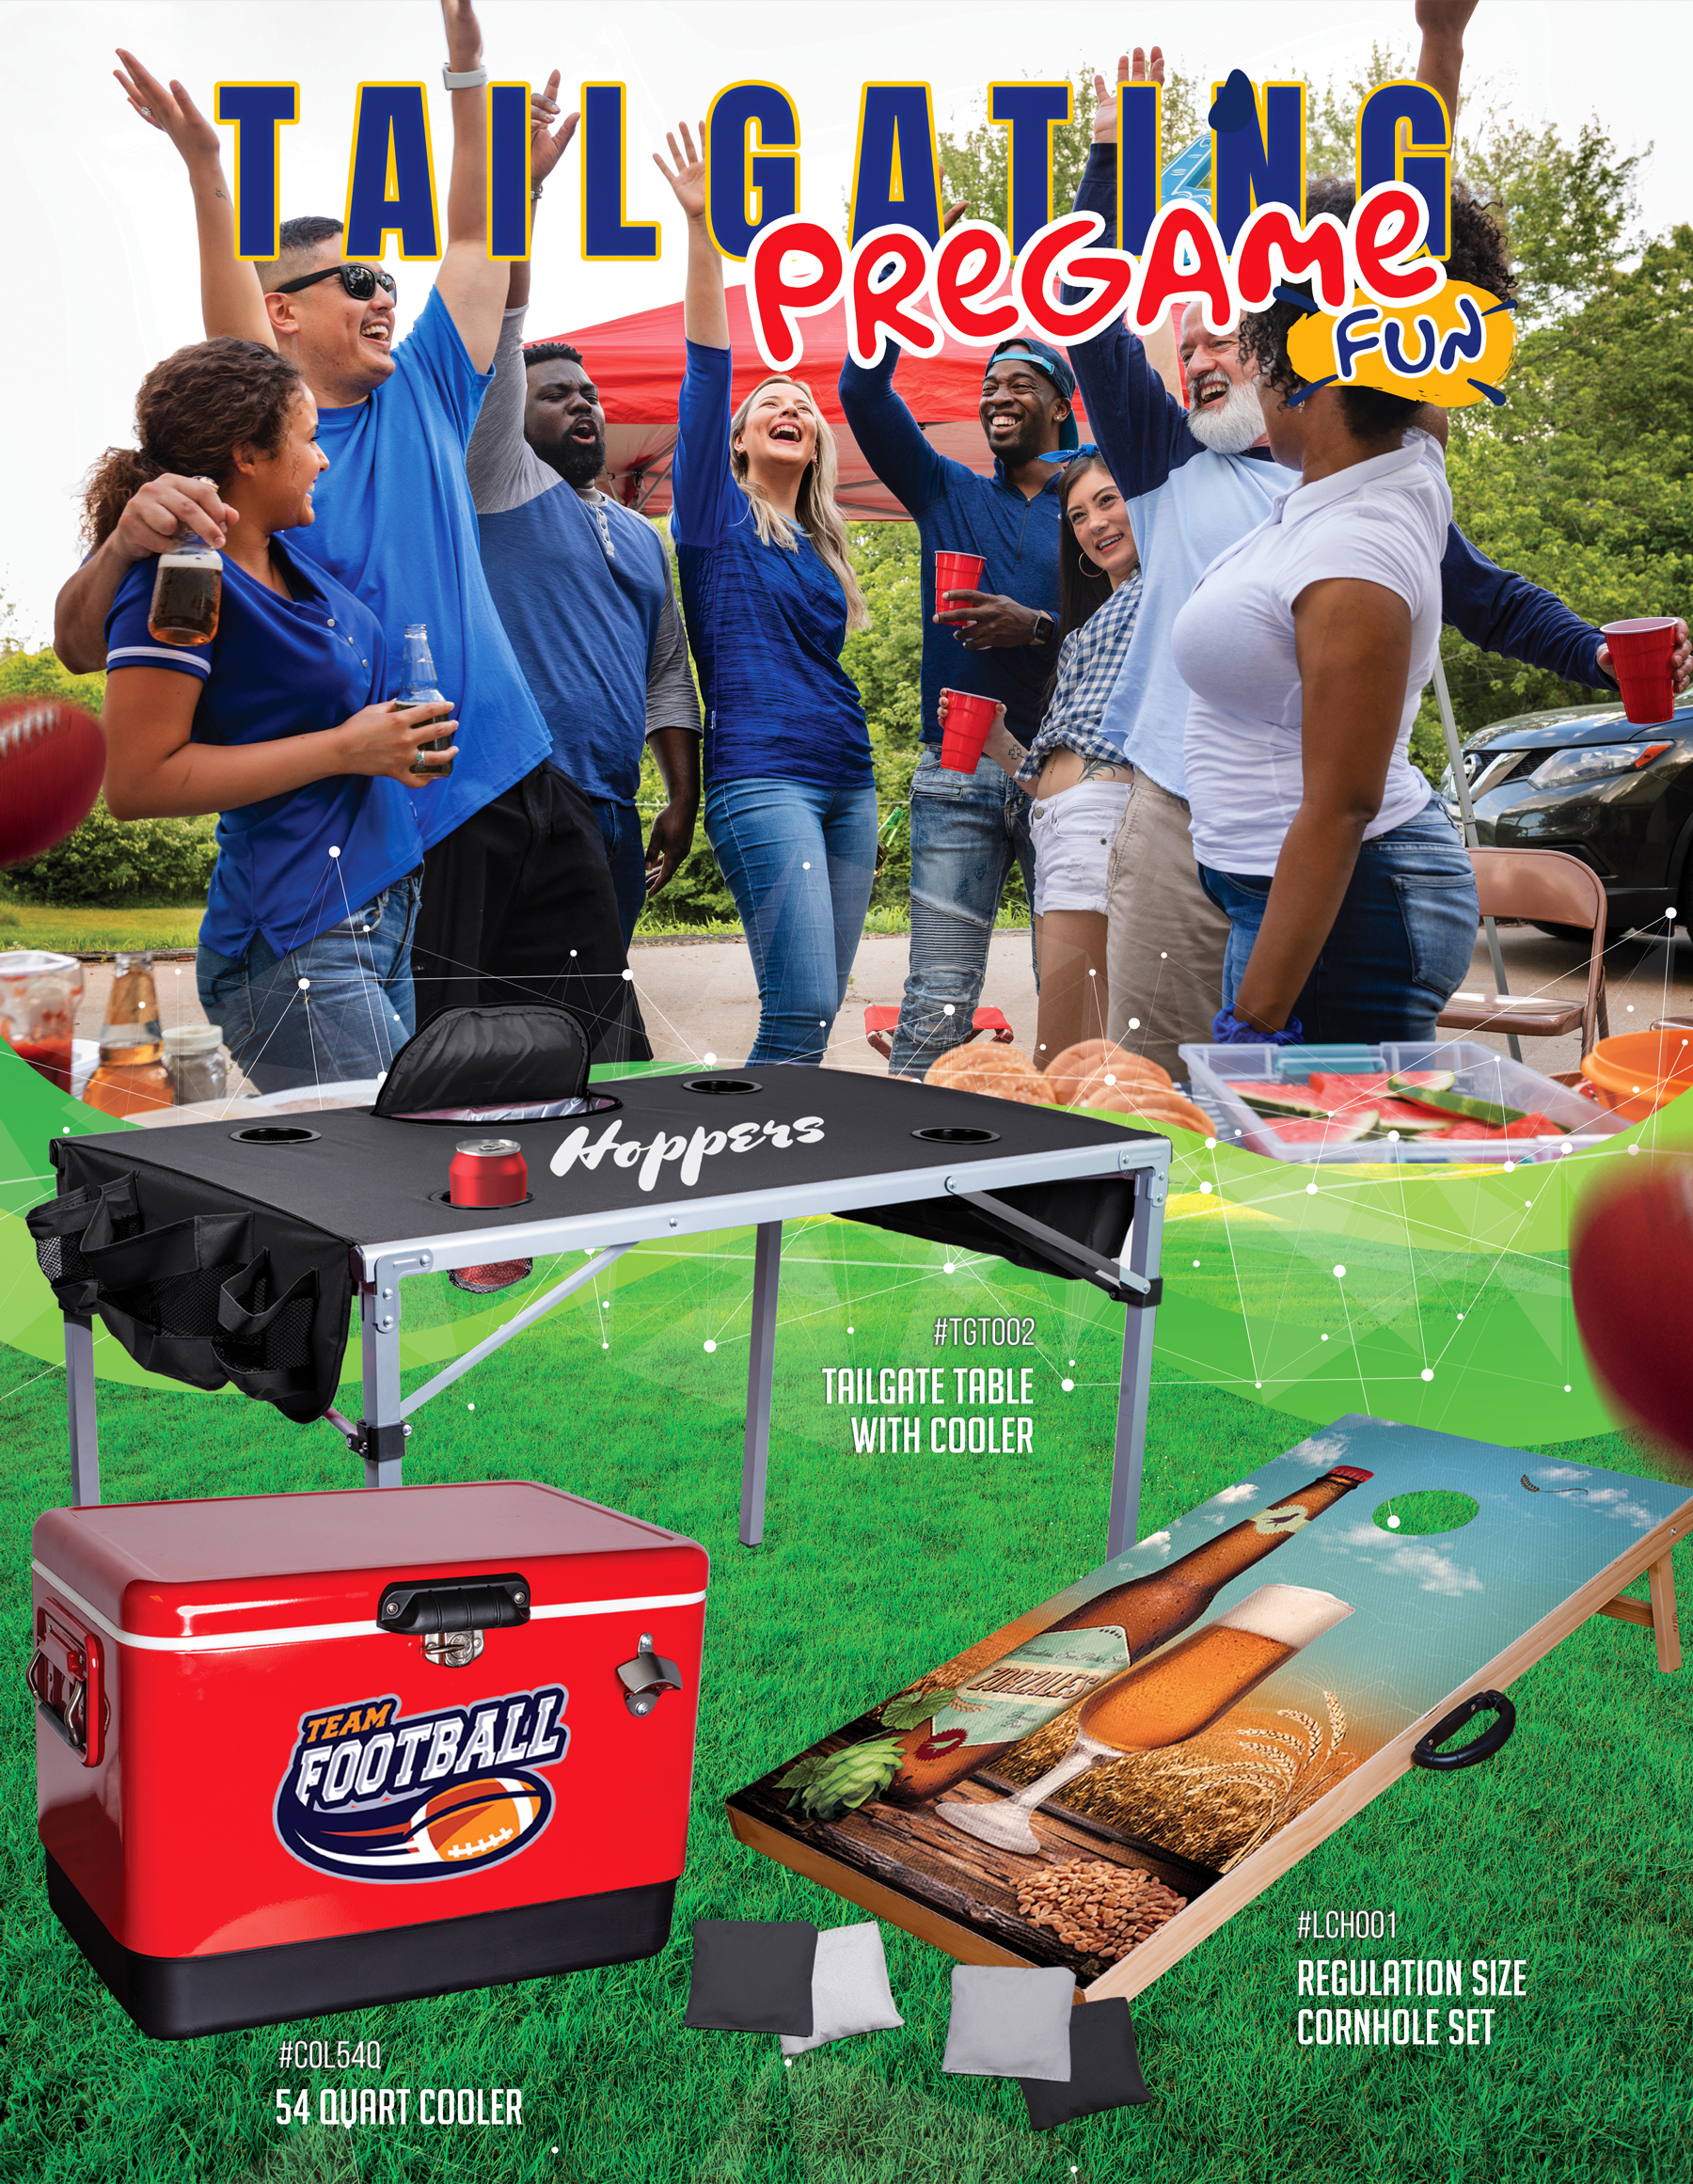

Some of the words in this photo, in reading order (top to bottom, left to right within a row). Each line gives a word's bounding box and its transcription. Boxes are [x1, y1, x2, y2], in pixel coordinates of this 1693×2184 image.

[549, 1116, 825, 1192] Hoppers
[966, 1667, 1101, 1700] ZORZALES
[295, 1695, 561, 1806] FOOTBALL
[307, 1703, 392, 1743] TEAM
